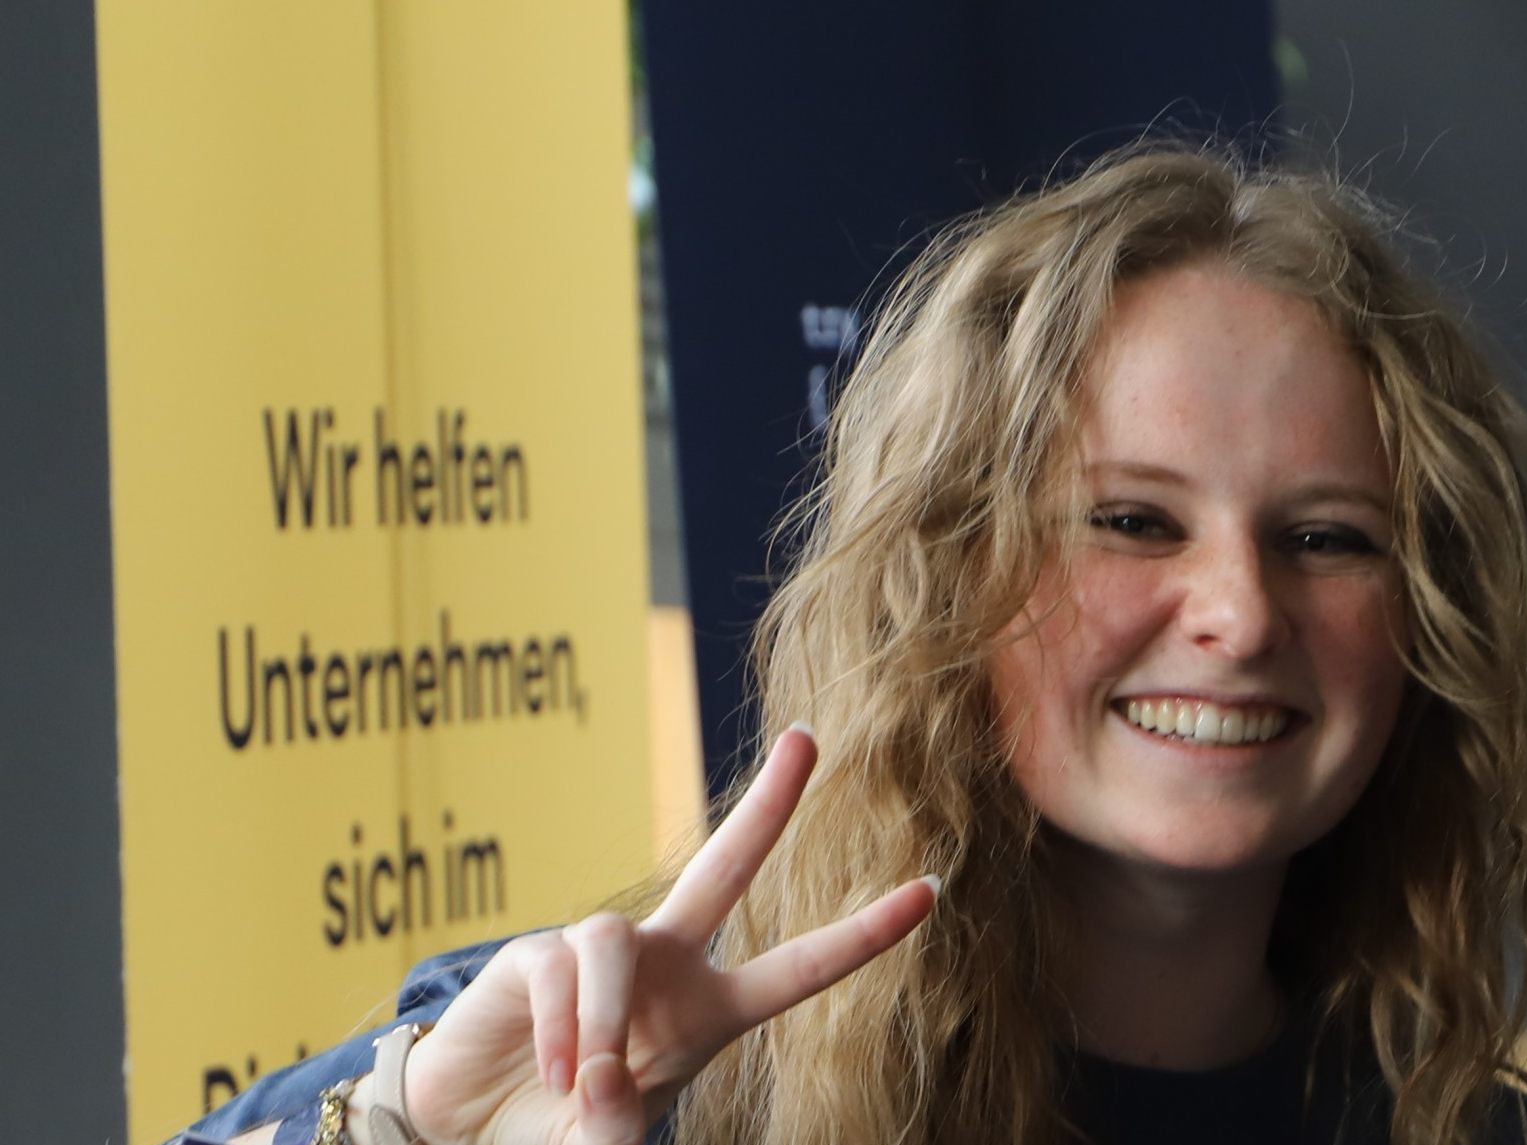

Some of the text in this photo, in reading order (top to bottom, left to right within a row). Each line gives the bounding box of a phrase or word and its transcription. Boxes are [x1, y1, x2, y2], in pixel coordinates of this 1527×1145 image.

[262, 404, 530, 531] Wir helfen
[217, 607, 589, 753] Unternehmen,
[321, 811, 507, 950] sich im
